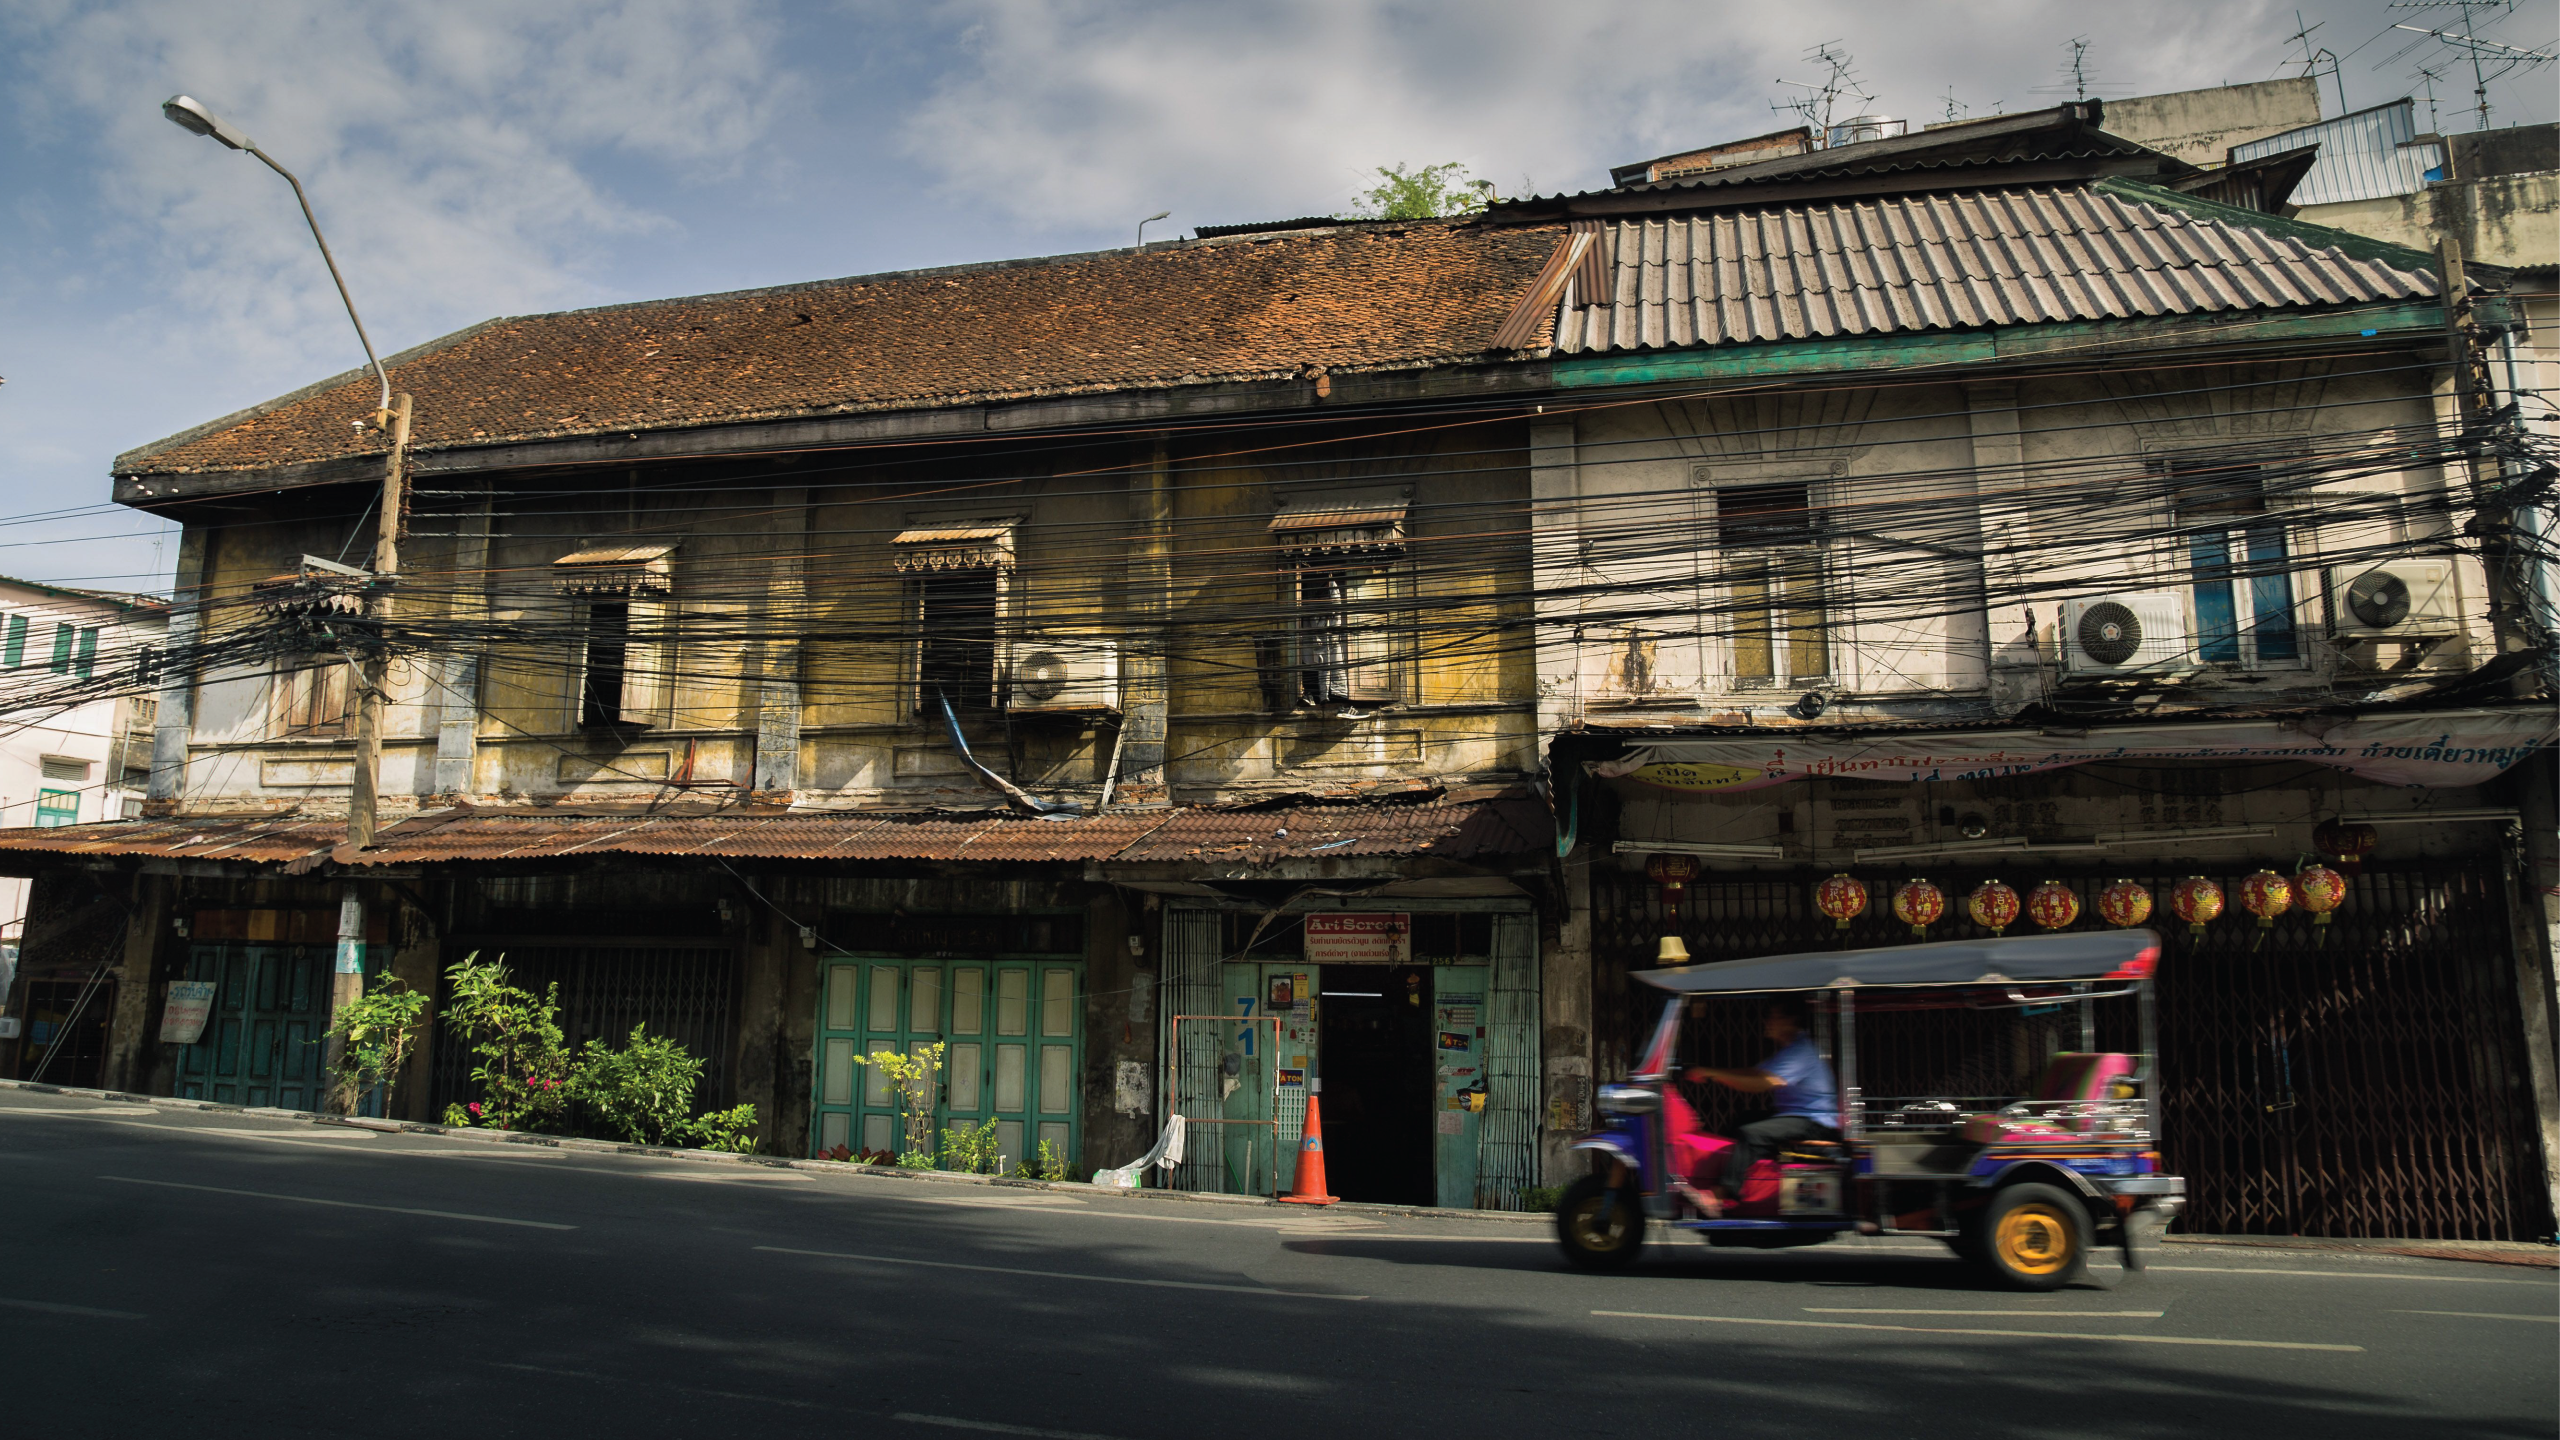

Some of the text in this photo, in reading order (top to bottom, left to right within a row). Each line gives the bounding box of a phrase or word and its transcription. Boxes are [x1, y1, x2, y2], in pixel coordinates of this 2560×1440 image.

[1308, 918, 1406, 931] Art Screen
[1432, 957, 1452, 965] 256
[1274, 1072, 1303, 1082] ATON
